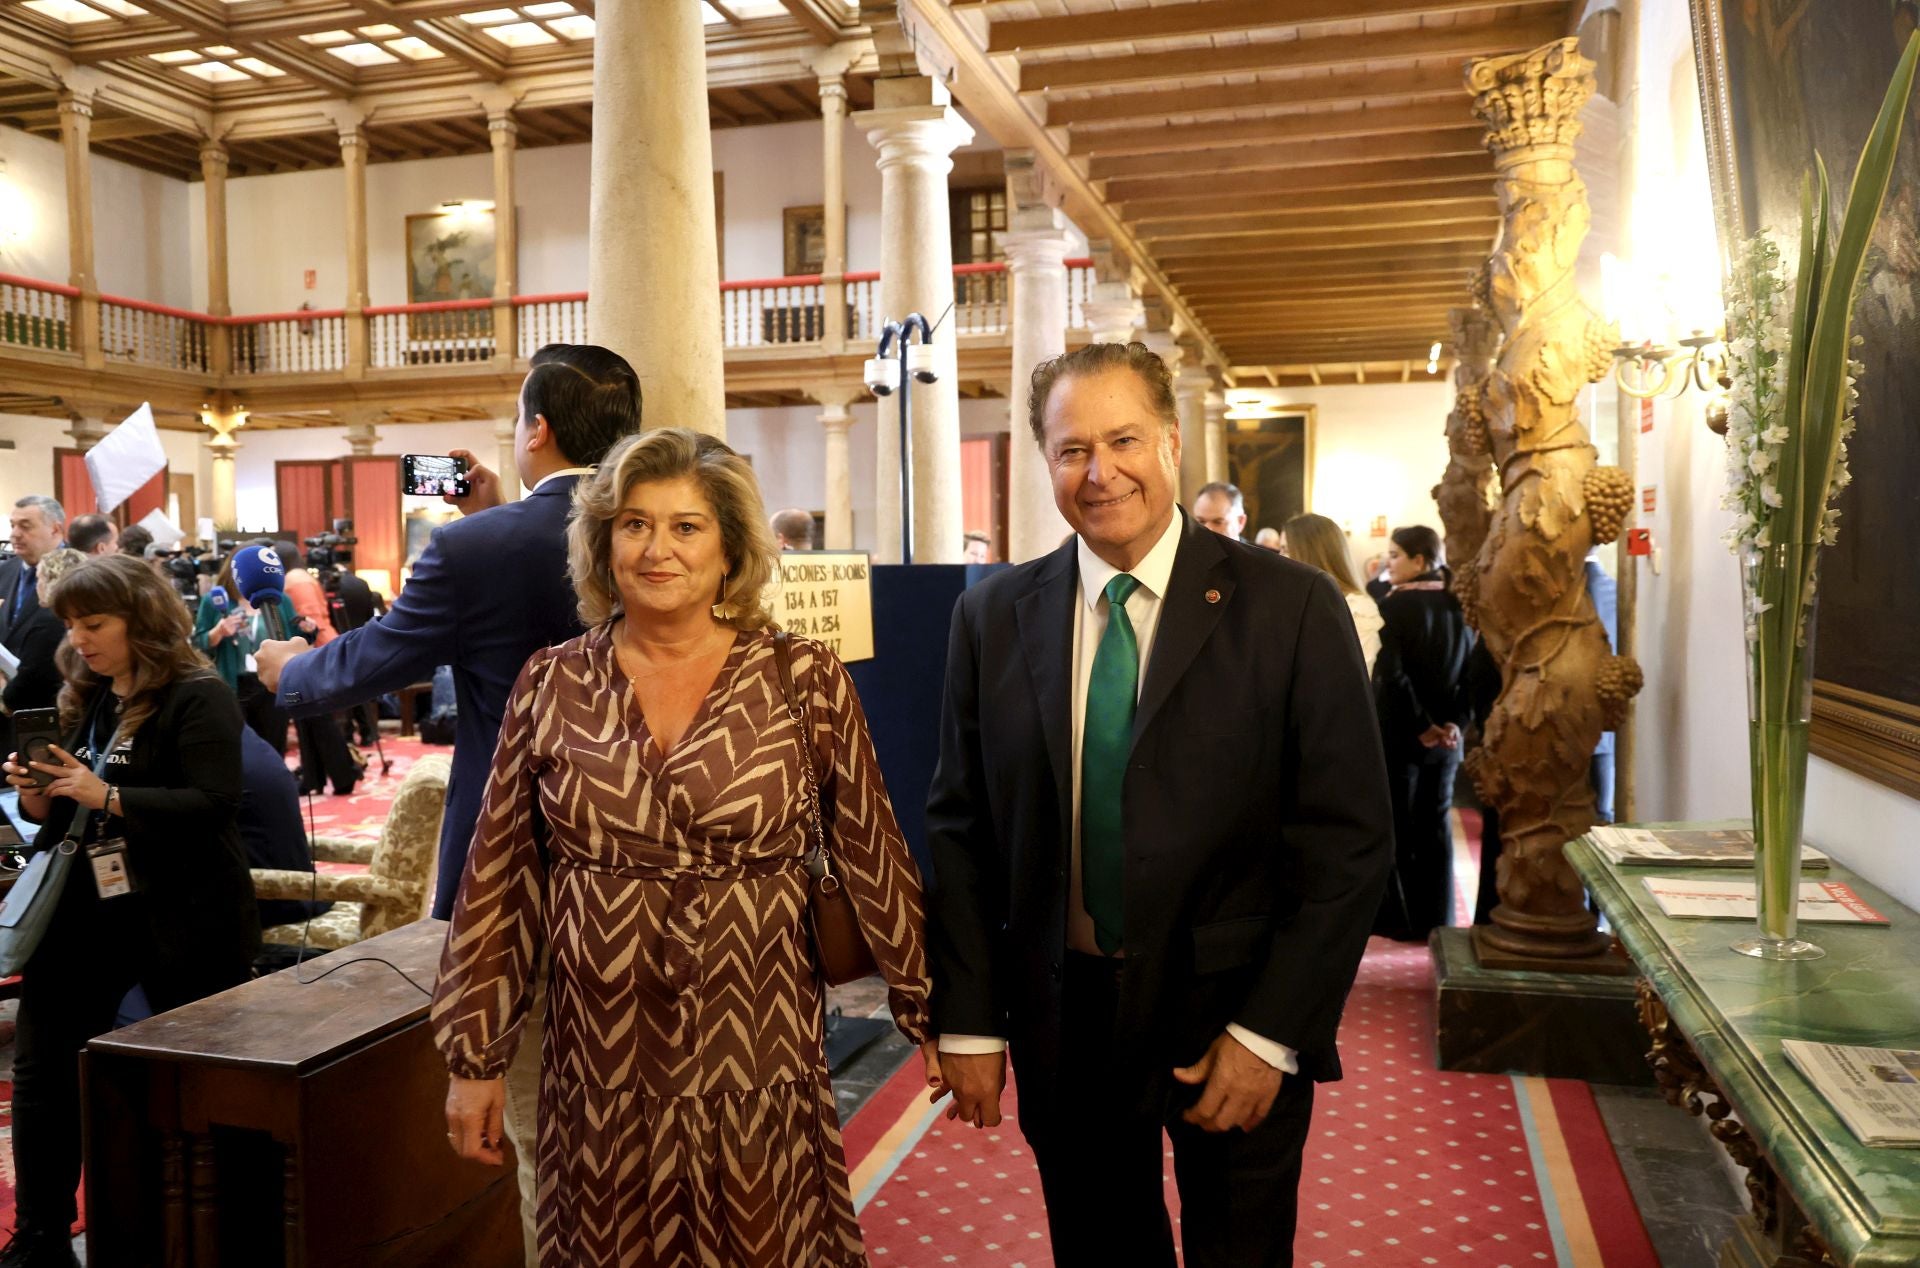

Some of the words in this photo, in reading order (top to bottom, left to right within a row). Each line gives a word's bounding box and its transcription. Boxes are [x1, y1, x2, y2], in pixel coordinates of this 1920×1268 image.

[784, 591, 805, 610] 134
[809, 591, 818, 609] A
[821, 589, 839, 608] 157
[786, 618, 808, 636] 228
[811, 617, 819, 635] A
[821, 614, 840, 633] 254
